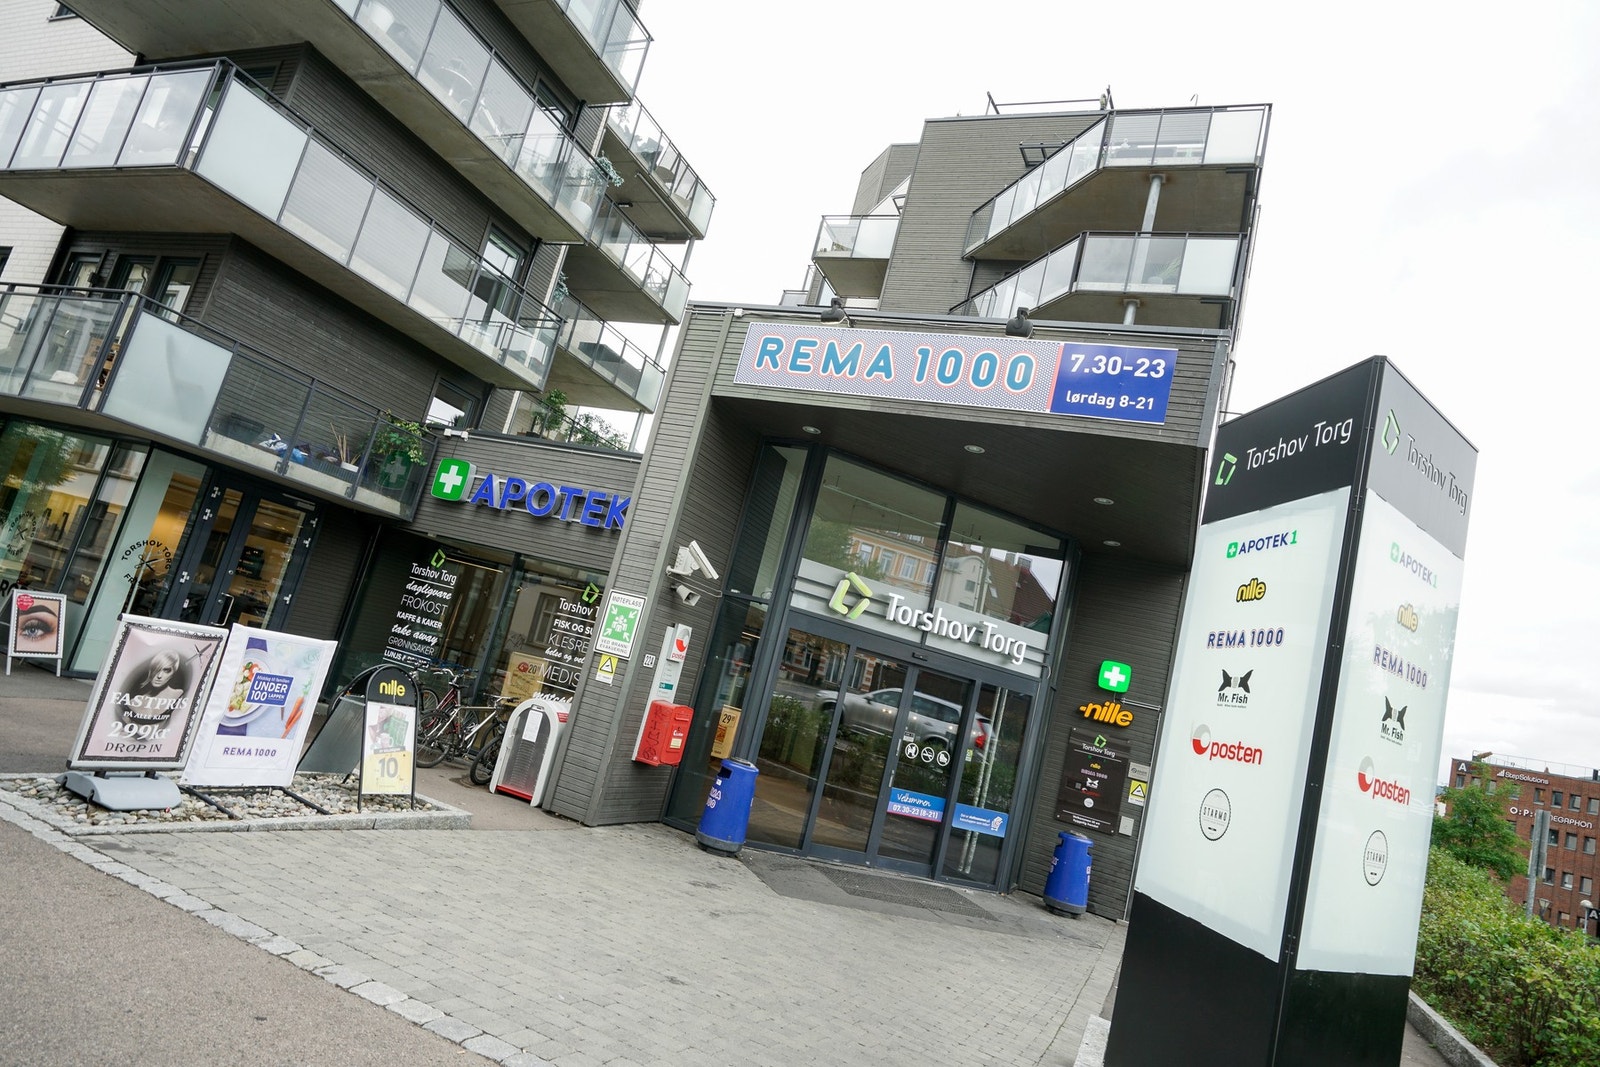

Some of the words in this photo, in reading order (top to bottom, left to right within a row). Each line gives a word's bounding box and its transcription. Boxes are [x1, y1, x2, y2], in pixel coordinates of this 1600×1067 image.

[754, 334, 896, 382] REMA
[912, 345, 1039, 394] 1000
[1069, 353, 1167, 380] 7.30-23
[1065, 390, 1116, 409] lørdag
[1118, 394, 1155, 411] 8-21
[1247, 433, 1308, 471] Torshov
[1314, 417, 1353, 447] Torg
[1407, 433, 1446, 490] Torshov
[1448, 472, 1468, 516] Torg
[470, 473, 632, 530] APOTEK
[1238, 531, 1288, 555] APOTEK
[1289, 530, 1298, 545] 1
[121, 540, 162, 561] TORSHOV
[162, 546, 172, 570] TORG
[411, 562, 440, 579] Torshov
[440, 569, 457, 586] Torg
[1399, 551, 1433, 585] APOTEK
[406, 580, 452, 600] dagligvare
[1236, 577, 1267, 603] nille
[400, 594, 448, 616] FROKOST
[558, 597, 594, 616] Torshov
[396, 610, 416, 623] KAFFE
[421, 616, 443, 630] KAKER
[553, 618, 570, 630] FISK
[571, 623, 584, 633] OG
[1397, 603, 1419, 632] nille
[391, 623, 412, 636] take
[413, 630, 439, 646] away
[885, 592, 977, 643] Torshov
[980, 621, 1027, 666] Torg
[1207, 630, 1246, 650] REMA
[1250, 627, 1286, 647] 1000
[387, 635, 435, 656] GRØNNSAKER
[548, 632, 590, 654] KLESRE
[539, 663, 581, 688] MEDIS
[1373, 644, 1404, 676] REMA
[1406, 662, 1428, 689] 1000
[251, 690, 268, 701] 100
[254, 680, 288, 693] UNDER
[379, 680, 406, 697] nille
[109, 691, 189, 710] FASTPRIS
[1217, 692, 1229, 702] Mr.
[1231, 693, 1248, 704] Fish
[123, 710, 133, 718] PÅ
[134, 712, 151, 720] ALLE
[1079, 701, 1134, 727] nille
[107, 721, 171, 741] 299kr
[1380, 722, 1391, 736] Mr.
[1391, 726, 1404, 741] Fish
[105, 742, 147, 753] DROP
[149, 743, 163, 753] IN
[223, 747, 252, 756] REMA
[255, 748, 277, 757] 1000
[1082, 743, 1103, 754] Torshov
[1103, 748, 1116, 758] Torg
[1209, 740, 1263, 765] posten
[378, 757, 398, 778] 10
[1504, 770, 1549, 785] StepSolutions
[1372, 777, 1410, 806] posten
